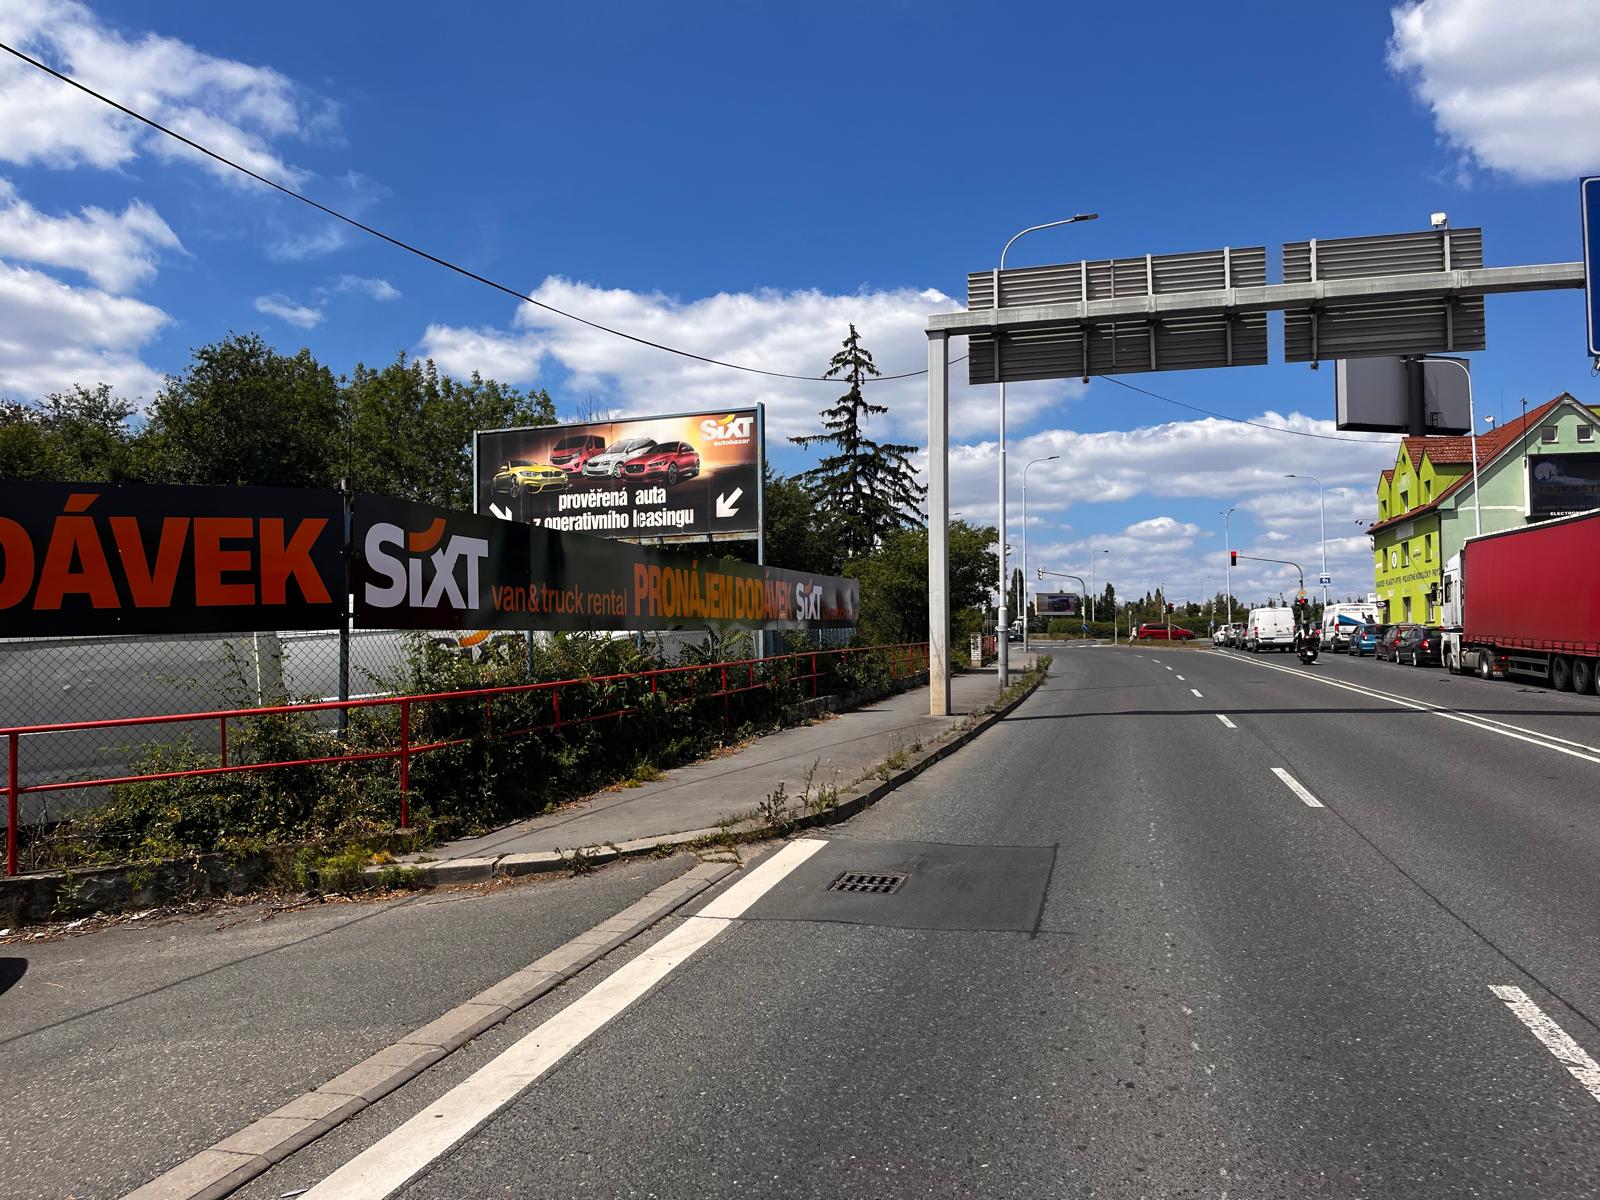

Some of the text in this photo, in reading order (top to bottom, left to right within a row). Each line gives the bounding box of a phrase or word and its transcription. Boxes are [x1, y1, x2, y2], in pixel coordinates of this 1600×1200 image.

[713, 438, 751, 447] autobazar
[558, 486, 666, 512] prověřená auta
[544, 510, 629, 531] operativního
[633, 508, 694, 528] leasingu
[587, 588, 628, 616] rental
[633, 560, 793, 620] PRONÁJEM DODÁVEK
